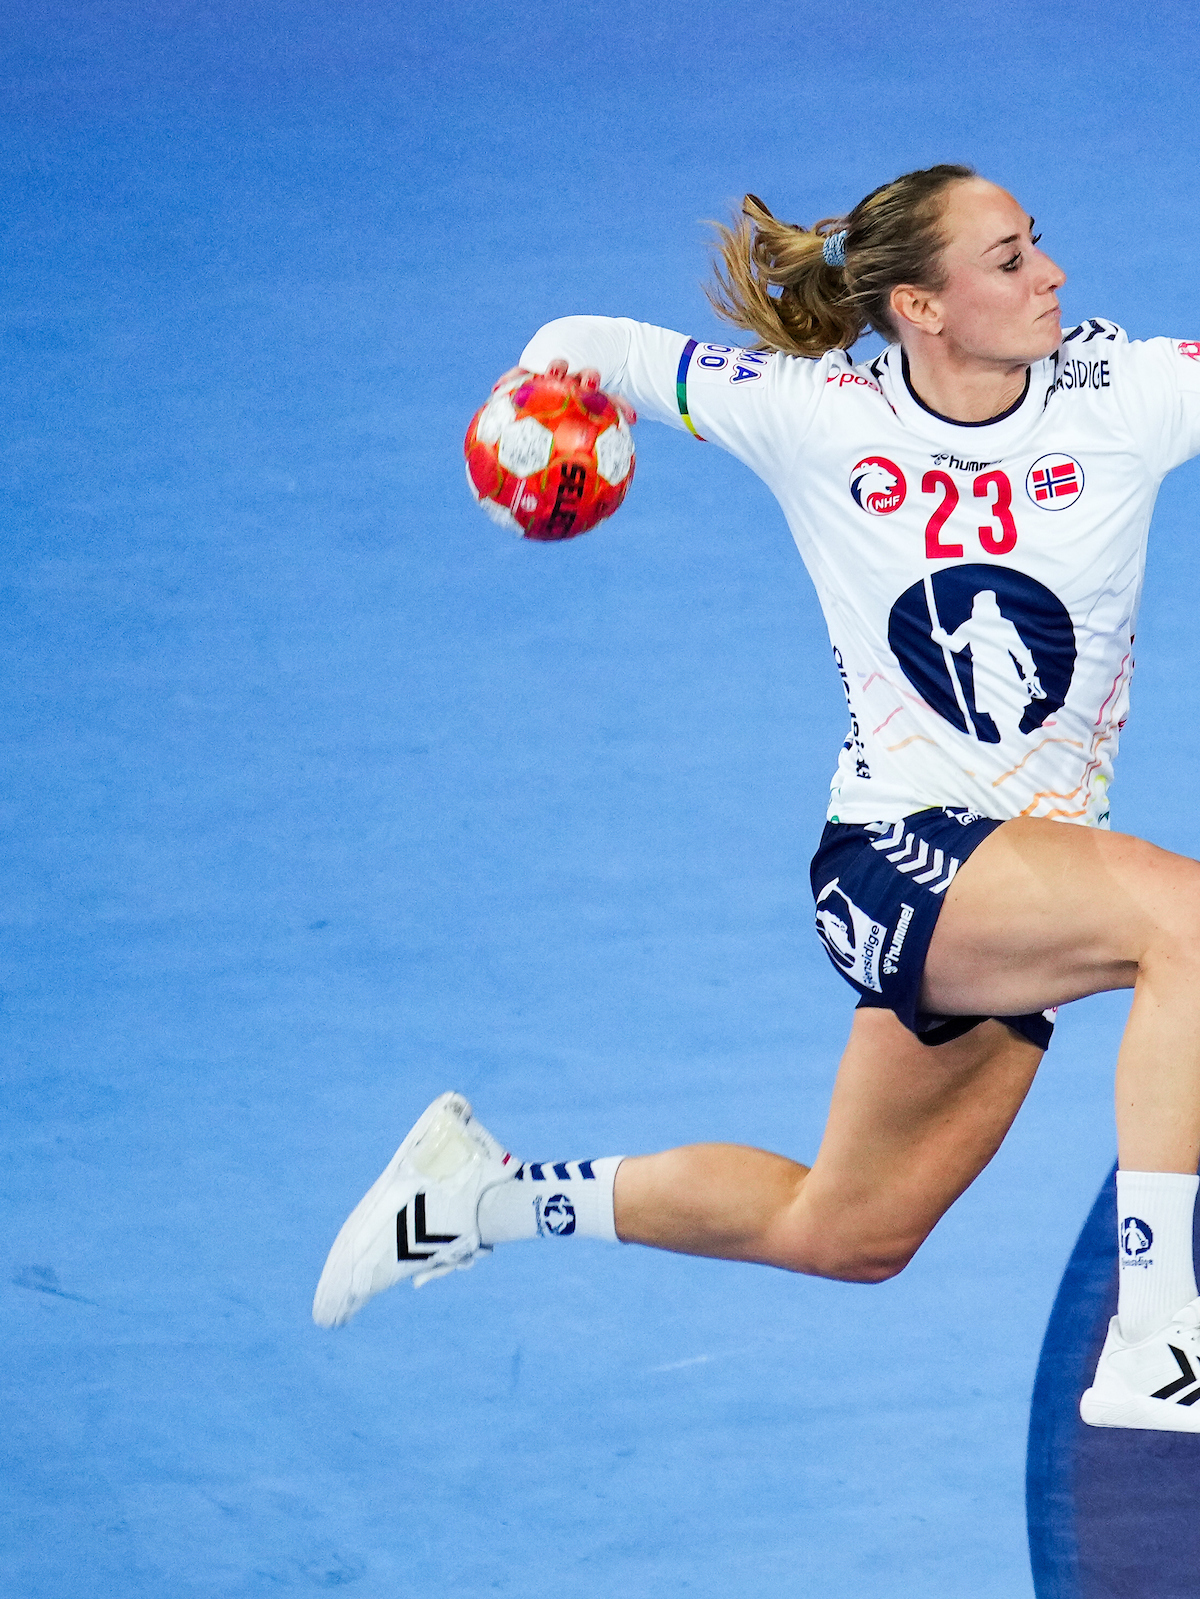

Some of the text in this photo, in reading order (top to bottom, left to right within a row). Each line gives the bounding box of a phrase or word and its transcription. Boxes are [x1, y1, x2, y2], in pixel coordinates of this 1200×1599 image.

[875, 495, 900, 510] NHF
[921, 469, 1018, 559] 23
[885, 902, 915, 962] hummel
